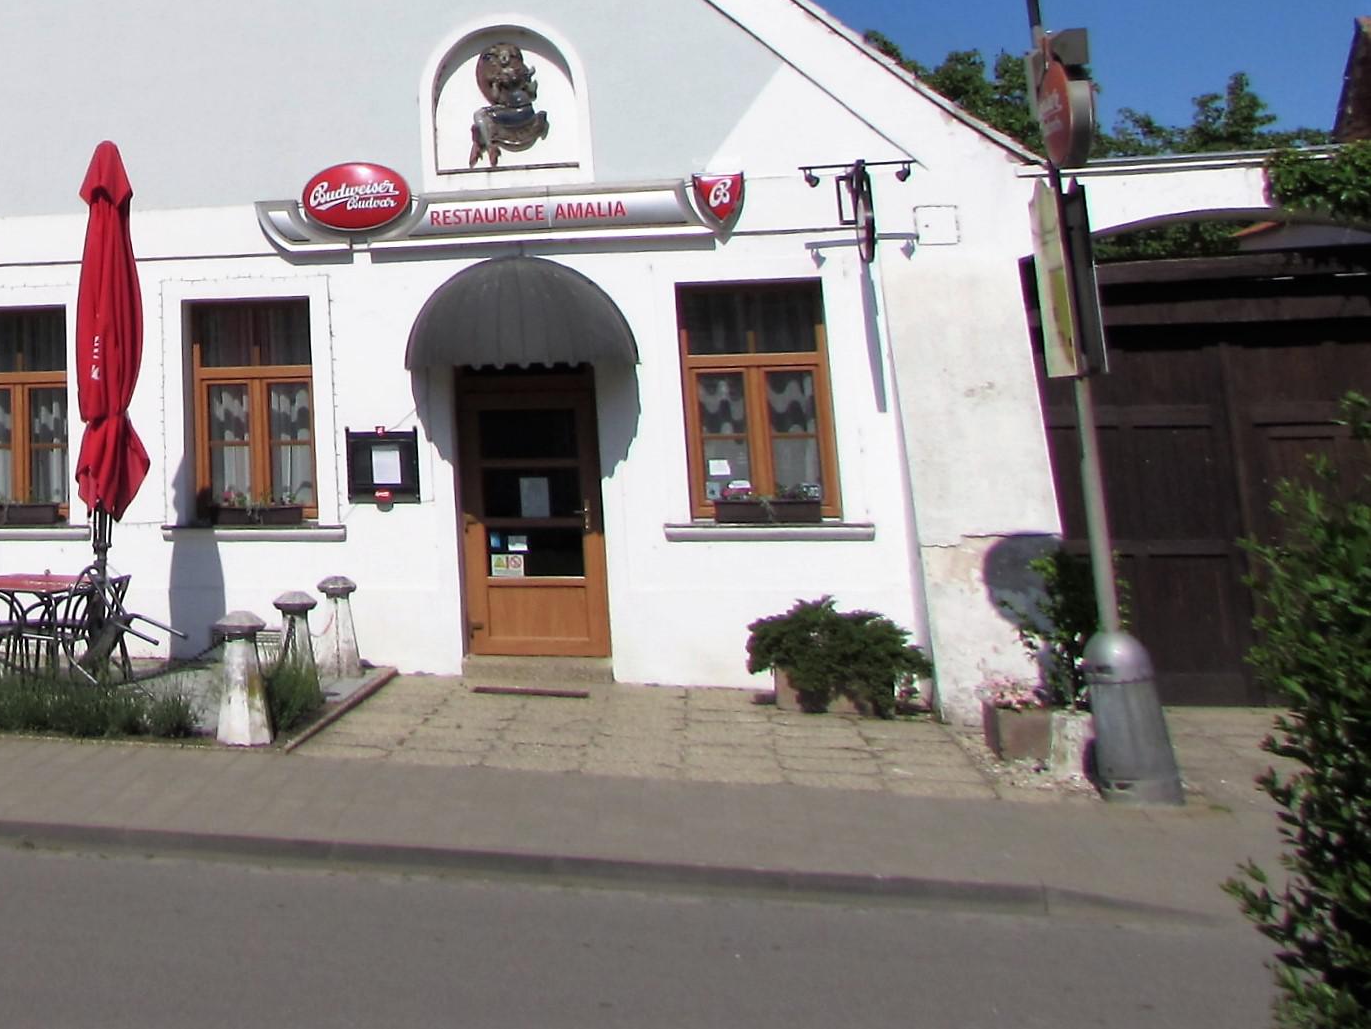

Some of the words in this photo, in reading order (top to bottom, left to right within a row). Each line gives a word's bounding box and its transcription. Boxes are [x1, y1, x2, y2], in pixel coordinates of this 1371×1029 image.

[310, 180, 398, 208] Budweiser
[346, 196, 397, 211] Budvar
[709, 178, 732, 207] B
[430, 204, 545, 226] RESTAURACE
[555, 201, 626, 220] AMALIA
